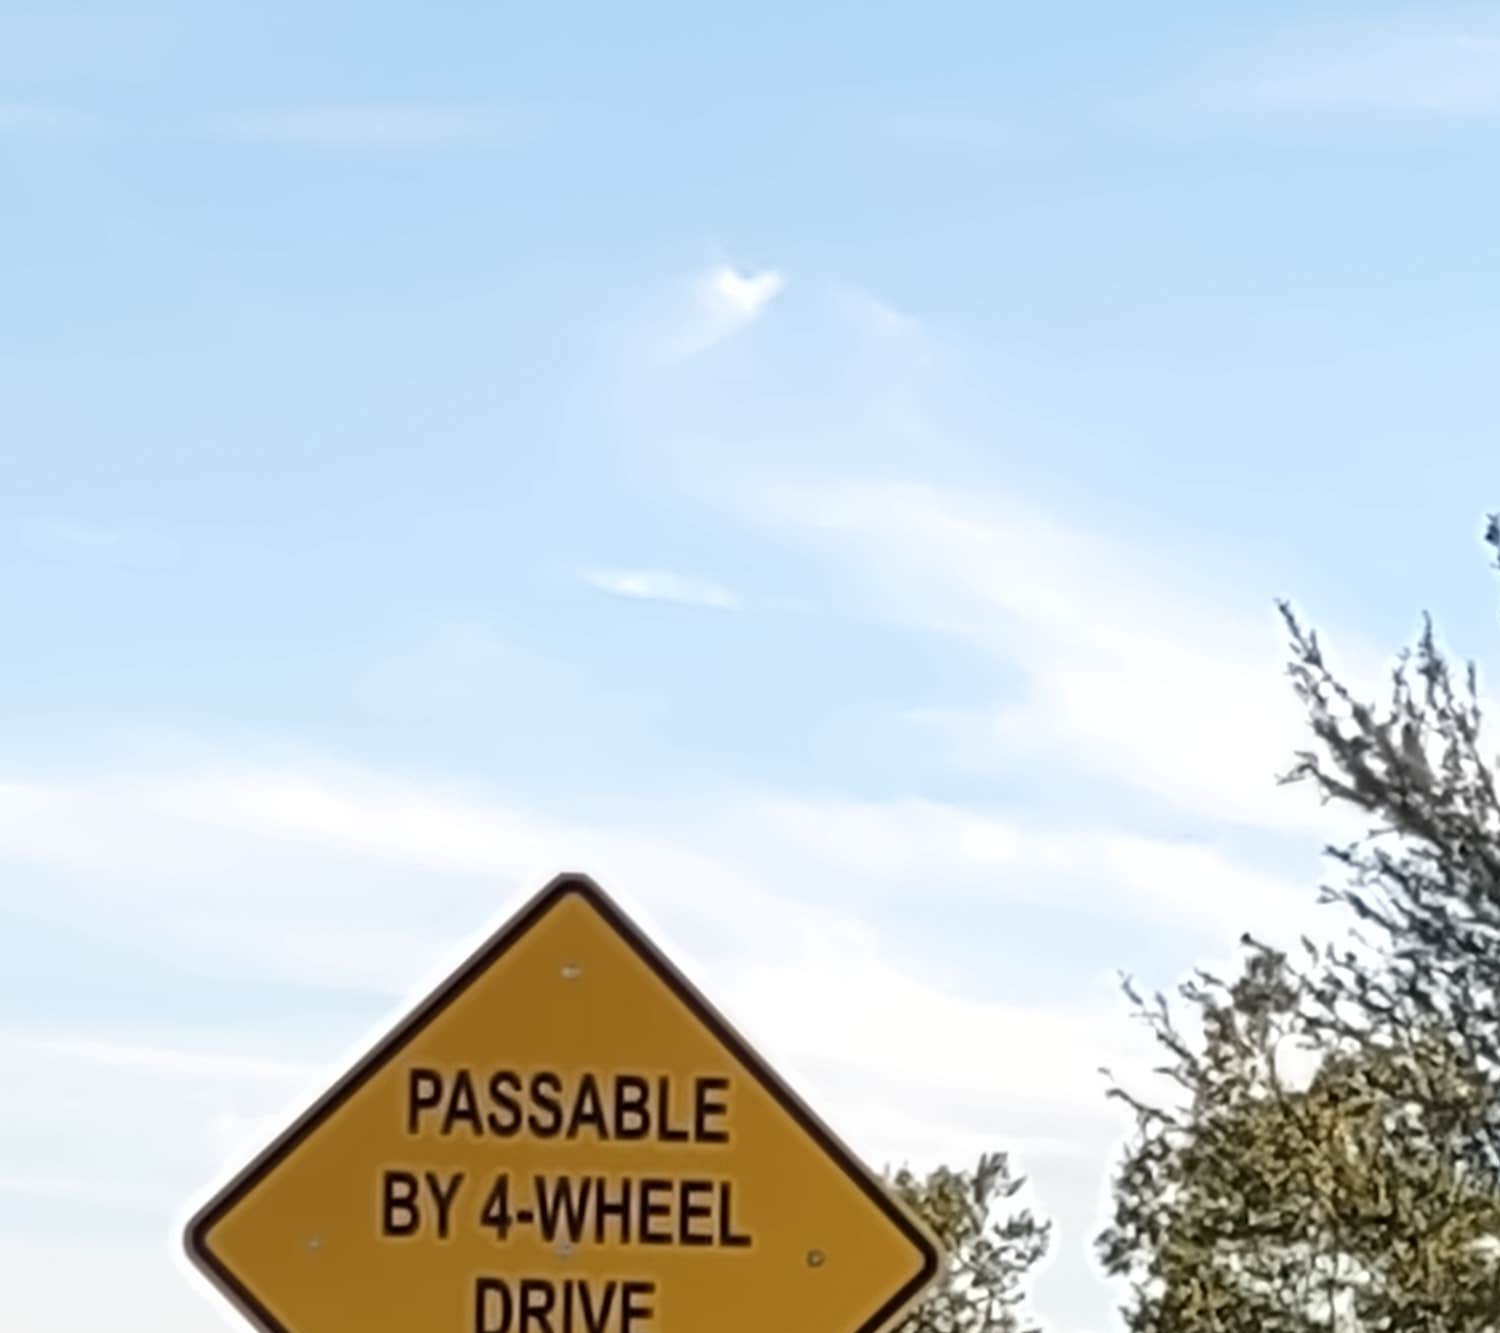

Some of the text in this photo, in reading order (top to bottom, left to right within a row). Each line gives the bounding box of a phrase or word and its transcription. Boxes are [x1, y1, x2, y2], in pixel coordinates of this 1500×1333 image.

[407, 1067, 731, 1144] PASSABLE
[381, 1170, 752, 1248] BY 4-WHEEL
